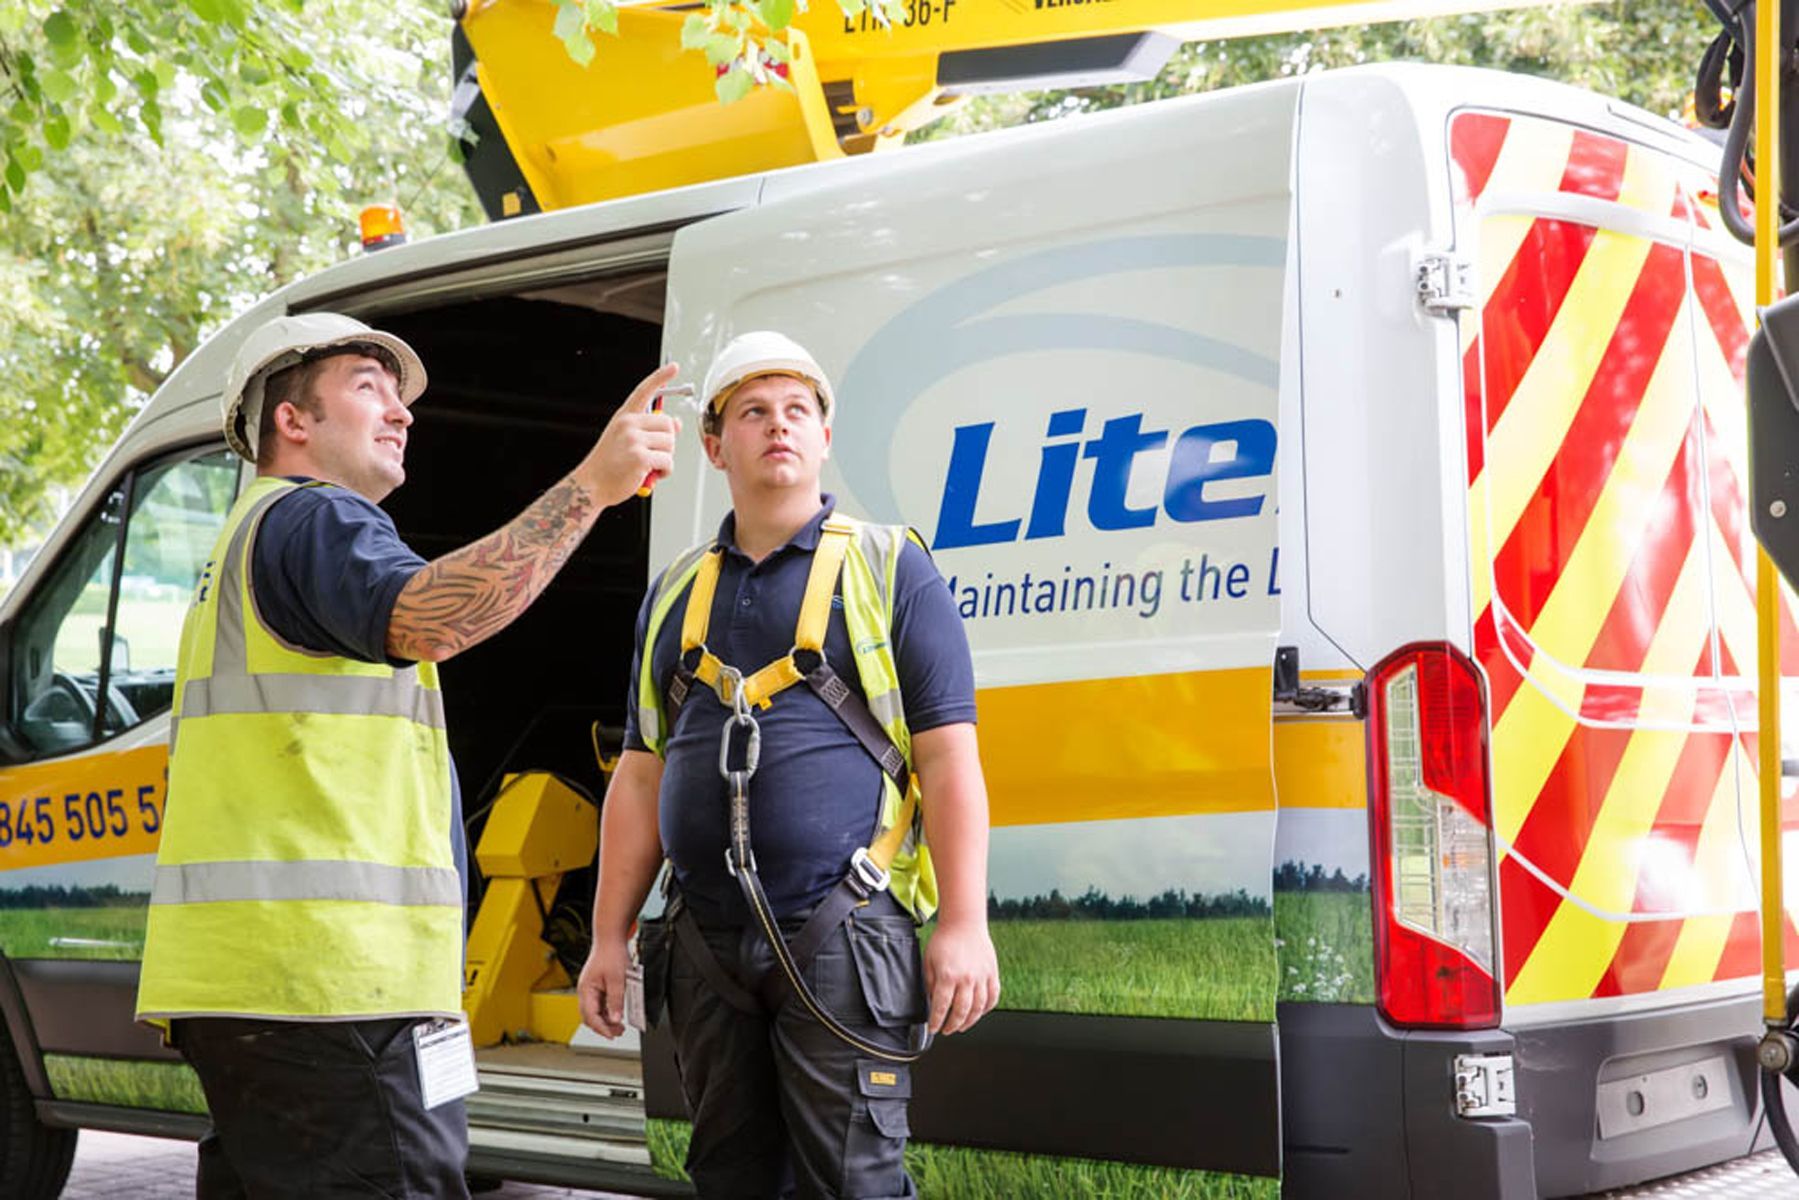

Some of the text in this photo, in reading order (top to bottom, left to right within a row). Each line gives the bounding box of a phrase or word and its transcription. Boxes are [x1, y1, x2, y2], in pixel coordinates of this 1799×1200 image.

[931, 407, 1279, 551] Lite
[1180, 554, 1250, 602] the
[64, 789, 129, 841] 505
[137, 784, 166, 834] 5
